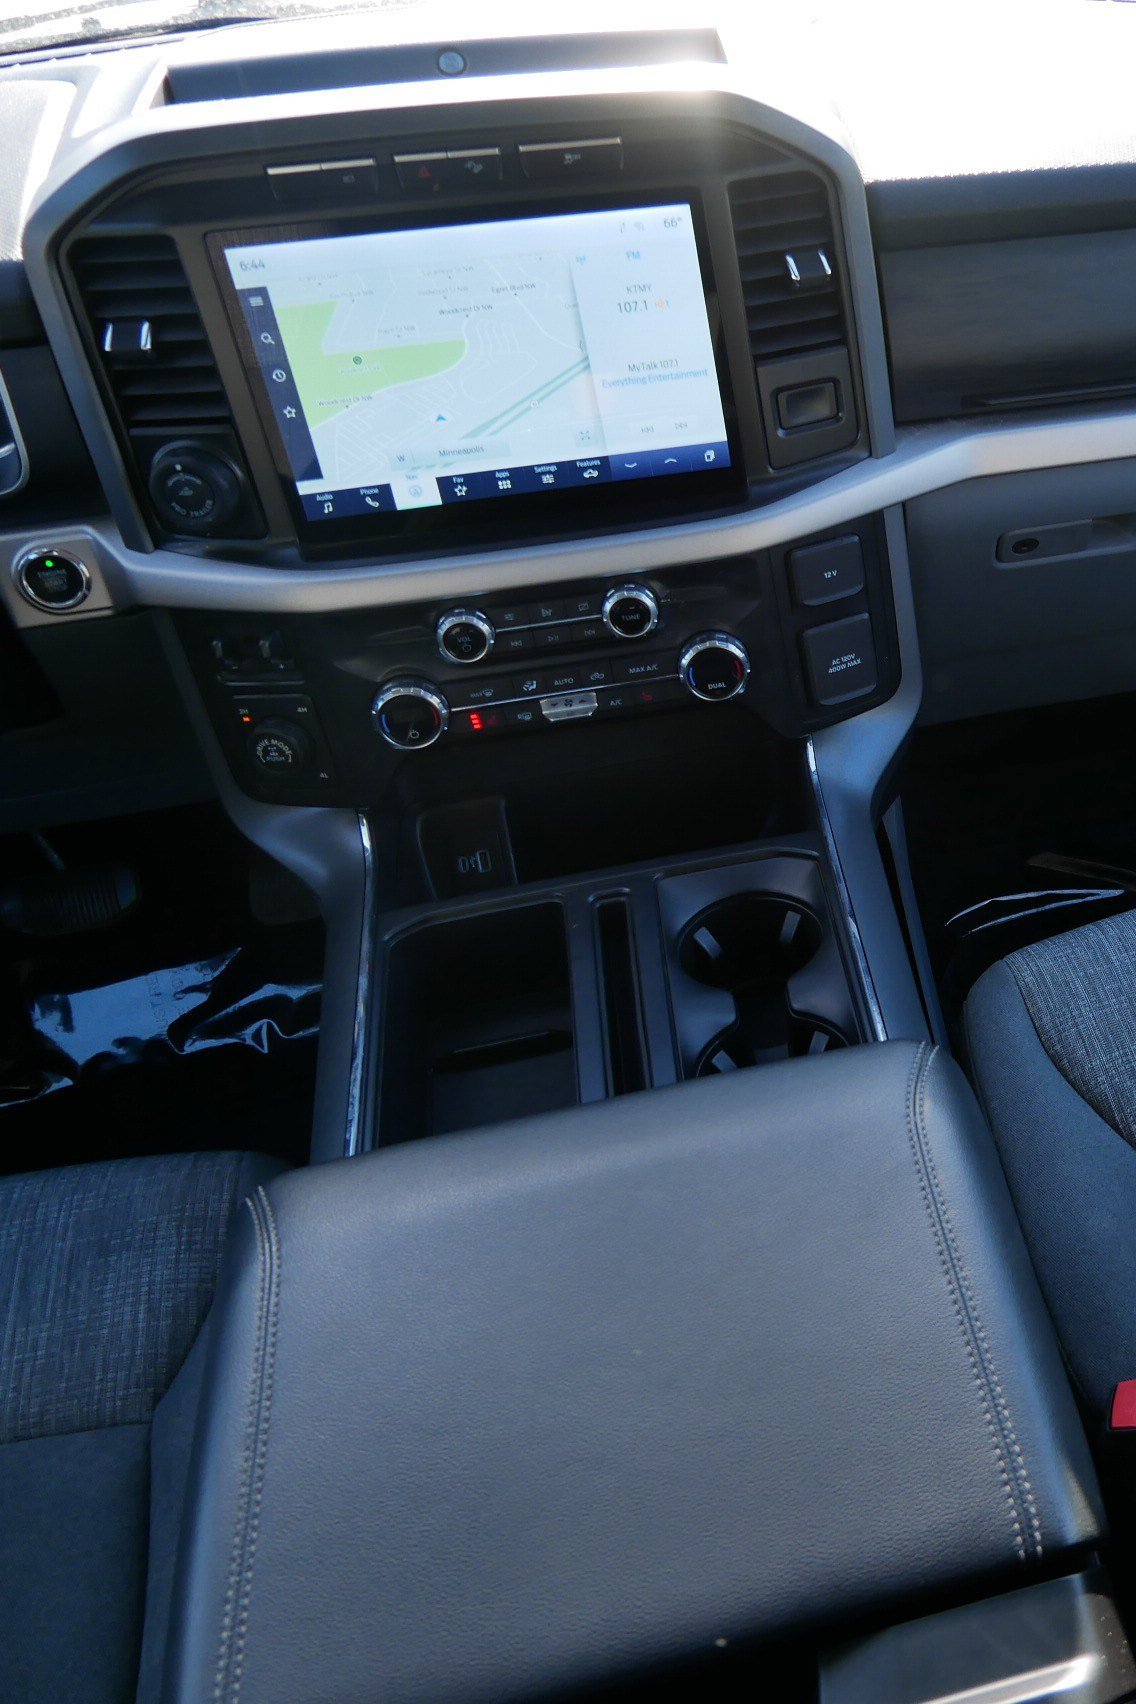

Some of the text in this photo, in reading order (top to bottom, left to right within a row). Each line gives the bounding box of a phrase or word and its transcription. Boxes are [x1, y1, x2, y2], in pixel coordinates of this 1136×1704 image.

[626, 250, 641, 260] FM
[239, 258, 267, 272] 6:44
[617, 299, 648, 313] 107.1
[628, 361, 659, 373] MyTalk
[601, 367, 709, 389] Everything Entertainment
[438, 445, 485, 458] Minneapolis
[397, 453, 405, 462] W
[576, 459, 601, 468] Features
[495, 470, 510, 478] Apps
[533, 464, 558, 474] Settings
[359, 487, 379, 496] Phone
[316, 493, 334, 502] Audio
[621, 613, 641, 622] TUNE
[456, 635, 472, 644] VOL
[629, 663, 659, 675] MAX A/C
[828, 658, 862, 674] 400W MAX
[554, 677, 574, 687] AUTO
[707, 681, 727, 690] DUAL
[609, 697, 625, 706] A/C
[257, 738, 293, 756] DRIVE MODE
